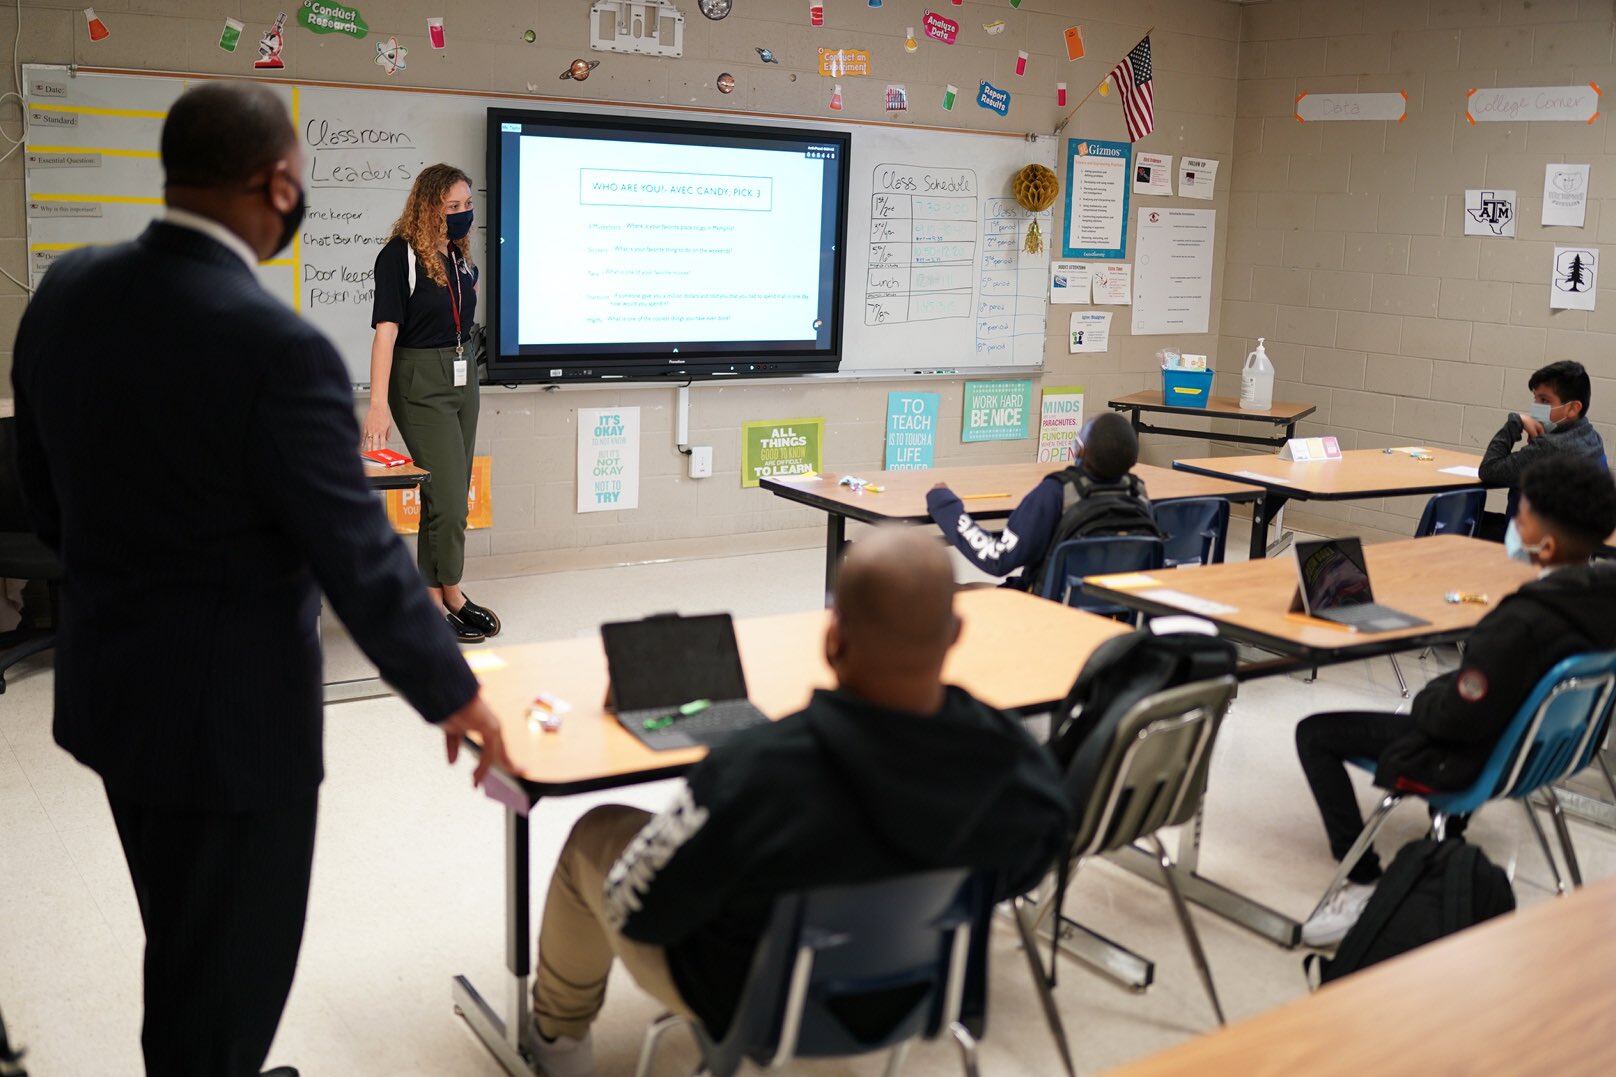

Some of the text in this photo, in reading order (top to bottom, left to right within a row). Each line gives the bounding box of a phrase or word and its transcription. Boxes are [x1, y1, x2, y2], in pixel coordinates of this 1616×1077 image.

[312, 2, 356, 21] Conduct
[307, 13, 357, 33] Research
[927, 16, 956, 33] Analyze
[931, 26, 949, 40] Data
[45, 85, 65, 94] Date:
[984, 86, 1007, 102] Report
[981, 95, 1006, 111] Results
[1320, 98, 1360, 115] Data
[1473, 92, 1584, 120] College Corner
[43, 115, 77, 125] Standard:
[306, 119, 411, 146] Classroom
[1089, 144, 1119, 157] Gizmos
[882, 171, 971, 193] Class Schedule
[592, 182, 618, 192] WHO
[620, 183, 638, 193] ARE
[670, 185, 694, 196] AVEC
[733, 187, 753, 198] PICK
[756, 189, 761, 198] 3
[992, 201, 1017, 218] Class
[303, 232, 330, 247] Chat
[332, 233, 351, 245] Box
[304, 264, 375, 289] Door Keepe
[870, 274, 899, 288] Lunch
[901, 398, 925, 414] TO
[972, 394, 1024, 409] WORK HARD
[1043, 400, 1080, 414] MINDS
[599, 414, 621, 426] IT'S
[892, 415, 932, 430] TEACH
[970, 408, 1022, 428] BE NICE
[593, 425, 625, 437] OKAY
[771, 427, 796, 439] ALL
[760, 436, 807, 448] THINGS
[888, 432, 933, 446] IS TO TOUCH A
[760, 446, 807, 461] GOOD TO KNOW
[896, 447, 922, 462] LIFE
[1040, 446, 1076, 463] OPEN
[596, 458, 620, 466] NOT
[592, 466, 624, 477] OKAY
[754, 463, 813, 477] TO LEARN
[594, 479, 622, 492] NOT TO
[595, 491, 621, 504] TRY
